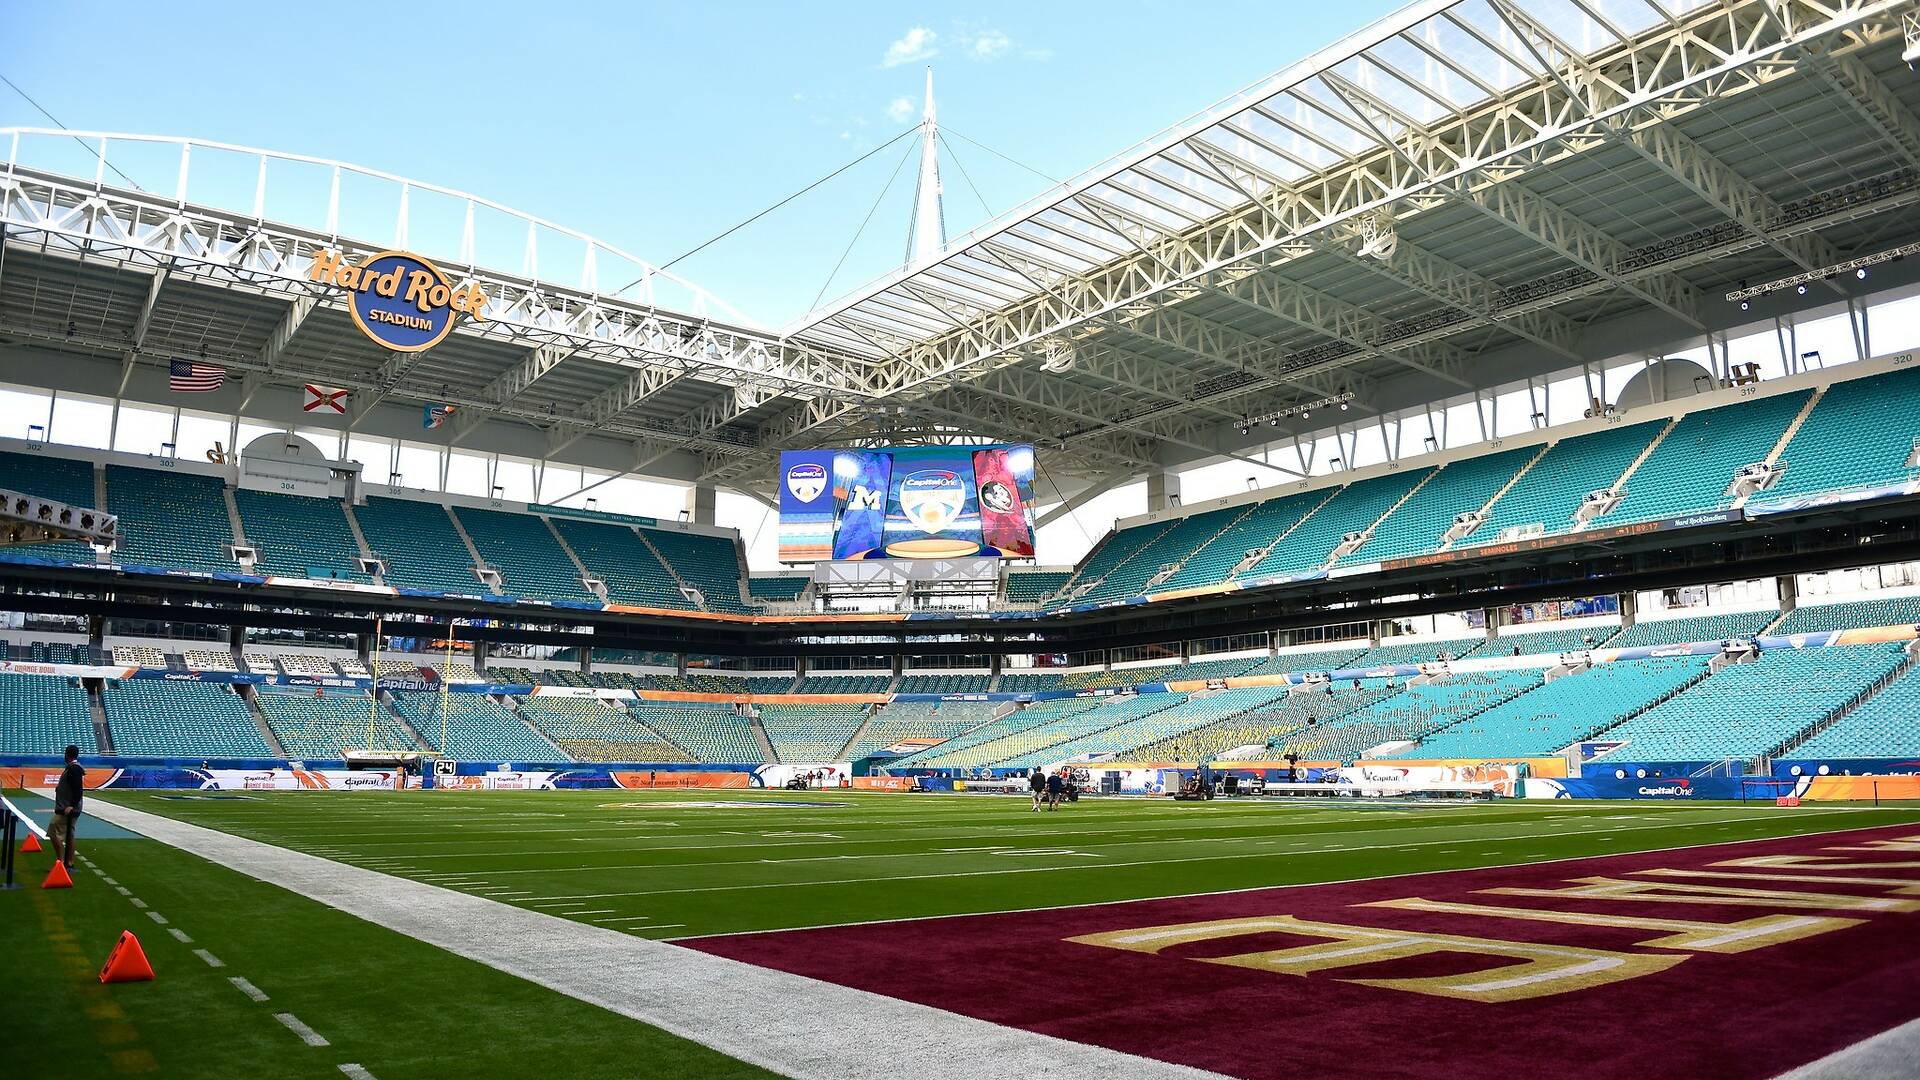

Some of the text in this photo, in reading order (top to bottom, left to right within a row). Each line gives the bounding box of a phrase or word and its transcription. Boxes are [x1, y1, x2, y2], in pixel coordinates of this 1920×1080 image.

[309, 249, 490, 323] Hard Rock
[368, 308, 433, 332] STADIUM
[1893, 353, 1912, 365] 320
[1741, 387, 1756, 396] 319
[1608, 415, 1621, 424] 318
[26, 443, 42, 451] 302
[1491, 441, 1502, 449] 317
[160, 459, 175, 468] 303
[280, 482, 295, 490] 304
[1674, 513, 1727, 526] Hard Rock Stadium
[1479, 544, 1518, 556] SEMINOLES
[437, 762, 453, 774] 24
